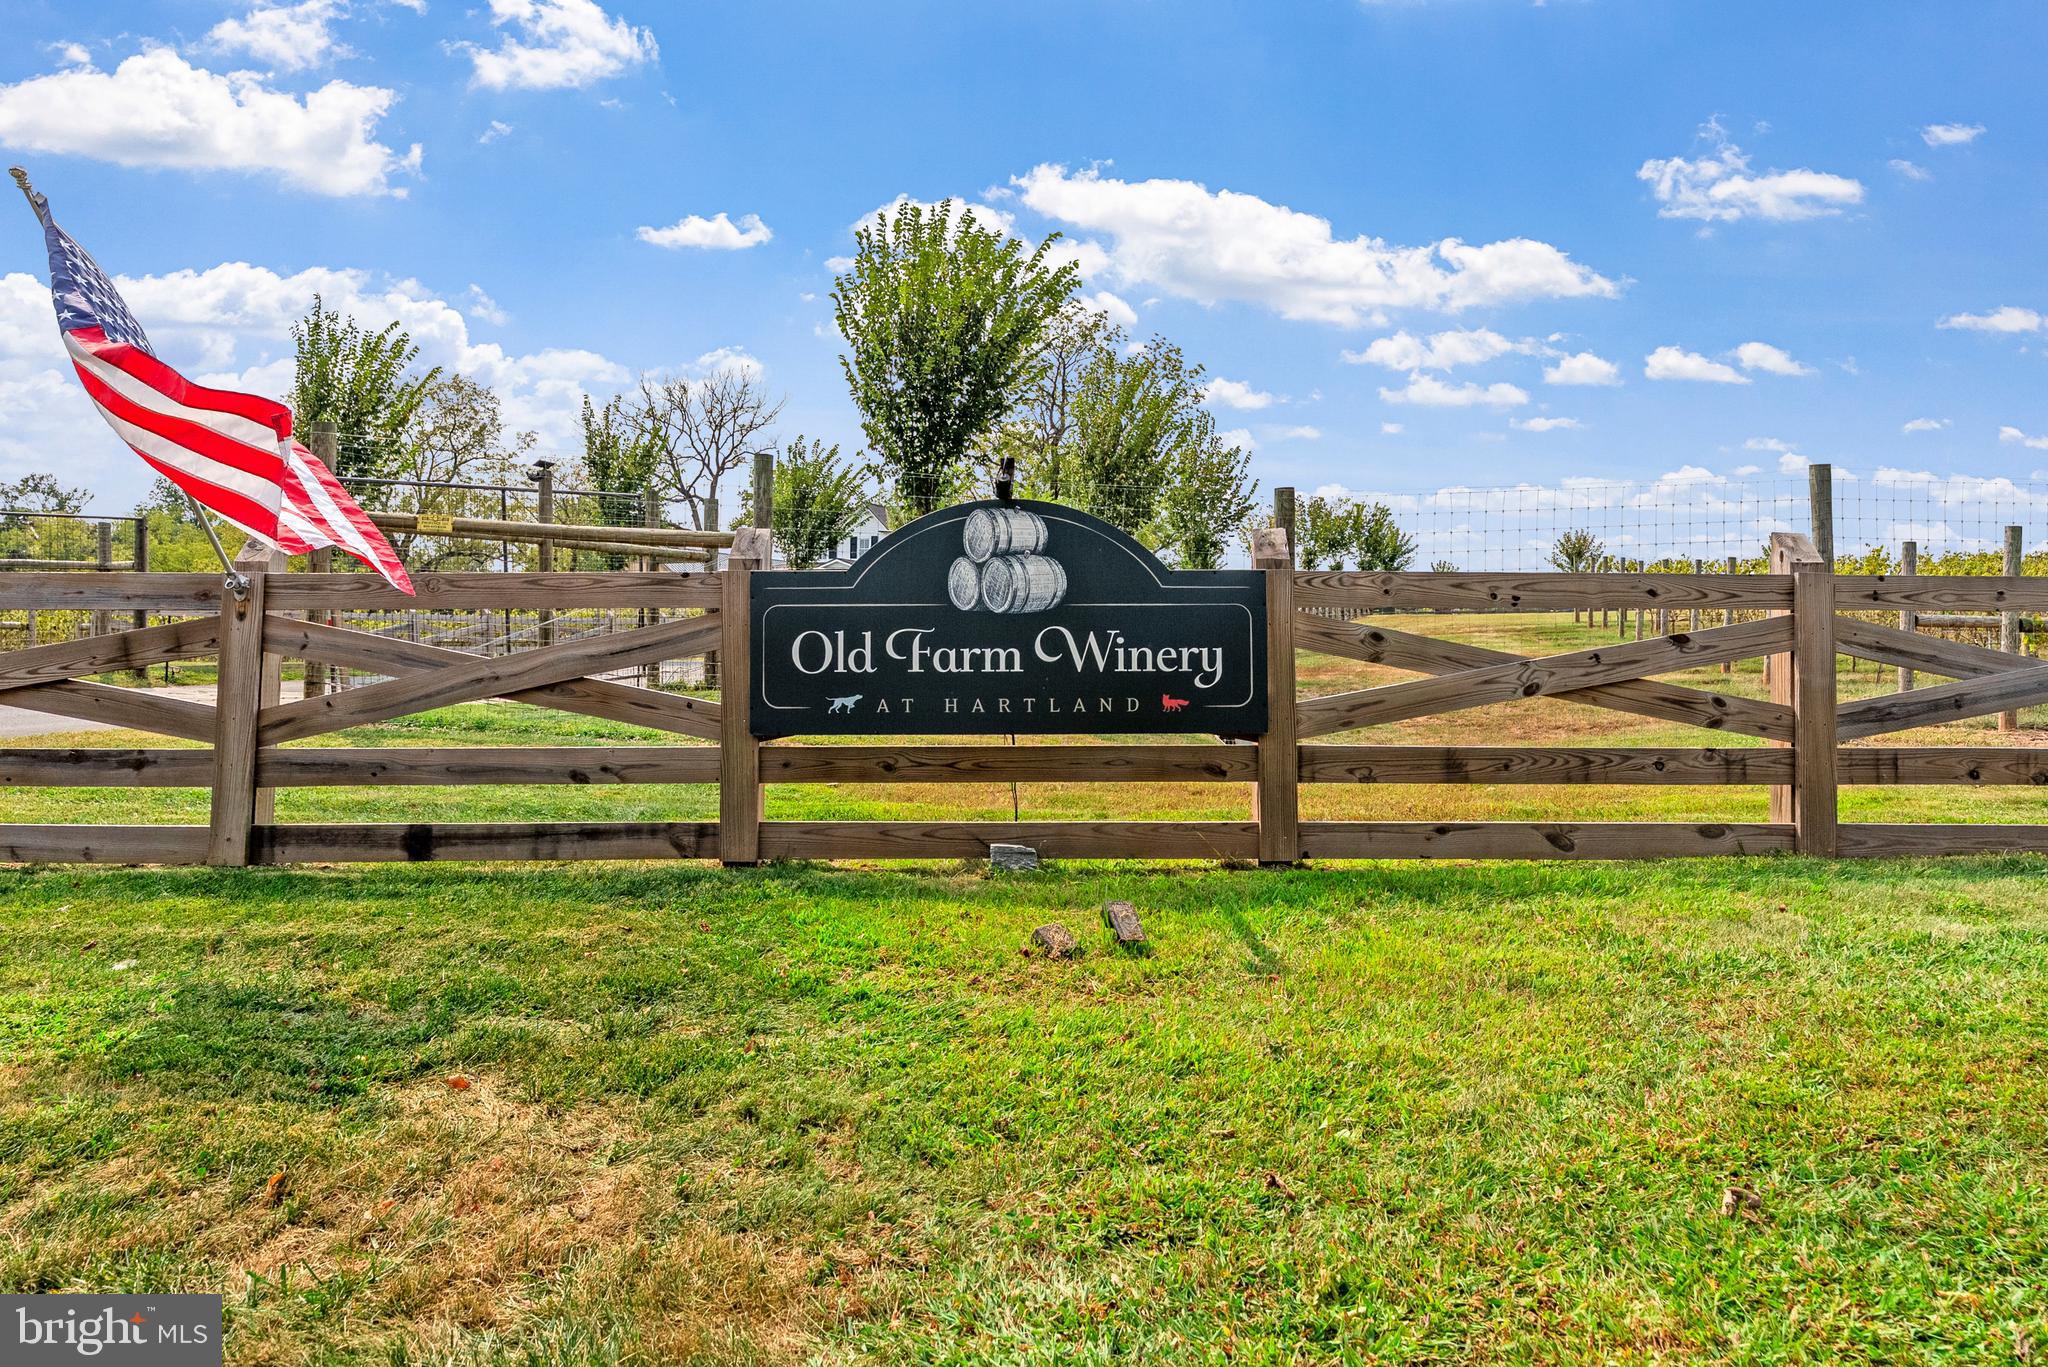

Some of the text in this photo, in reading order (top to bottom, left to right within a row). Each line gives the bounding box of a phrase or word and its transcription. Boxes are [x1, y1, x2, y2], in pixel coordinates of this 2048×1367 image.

[792, 626, 1222, 688] Old Farm Winery
[876, 697, 1139, 713] AT HARTLAND
